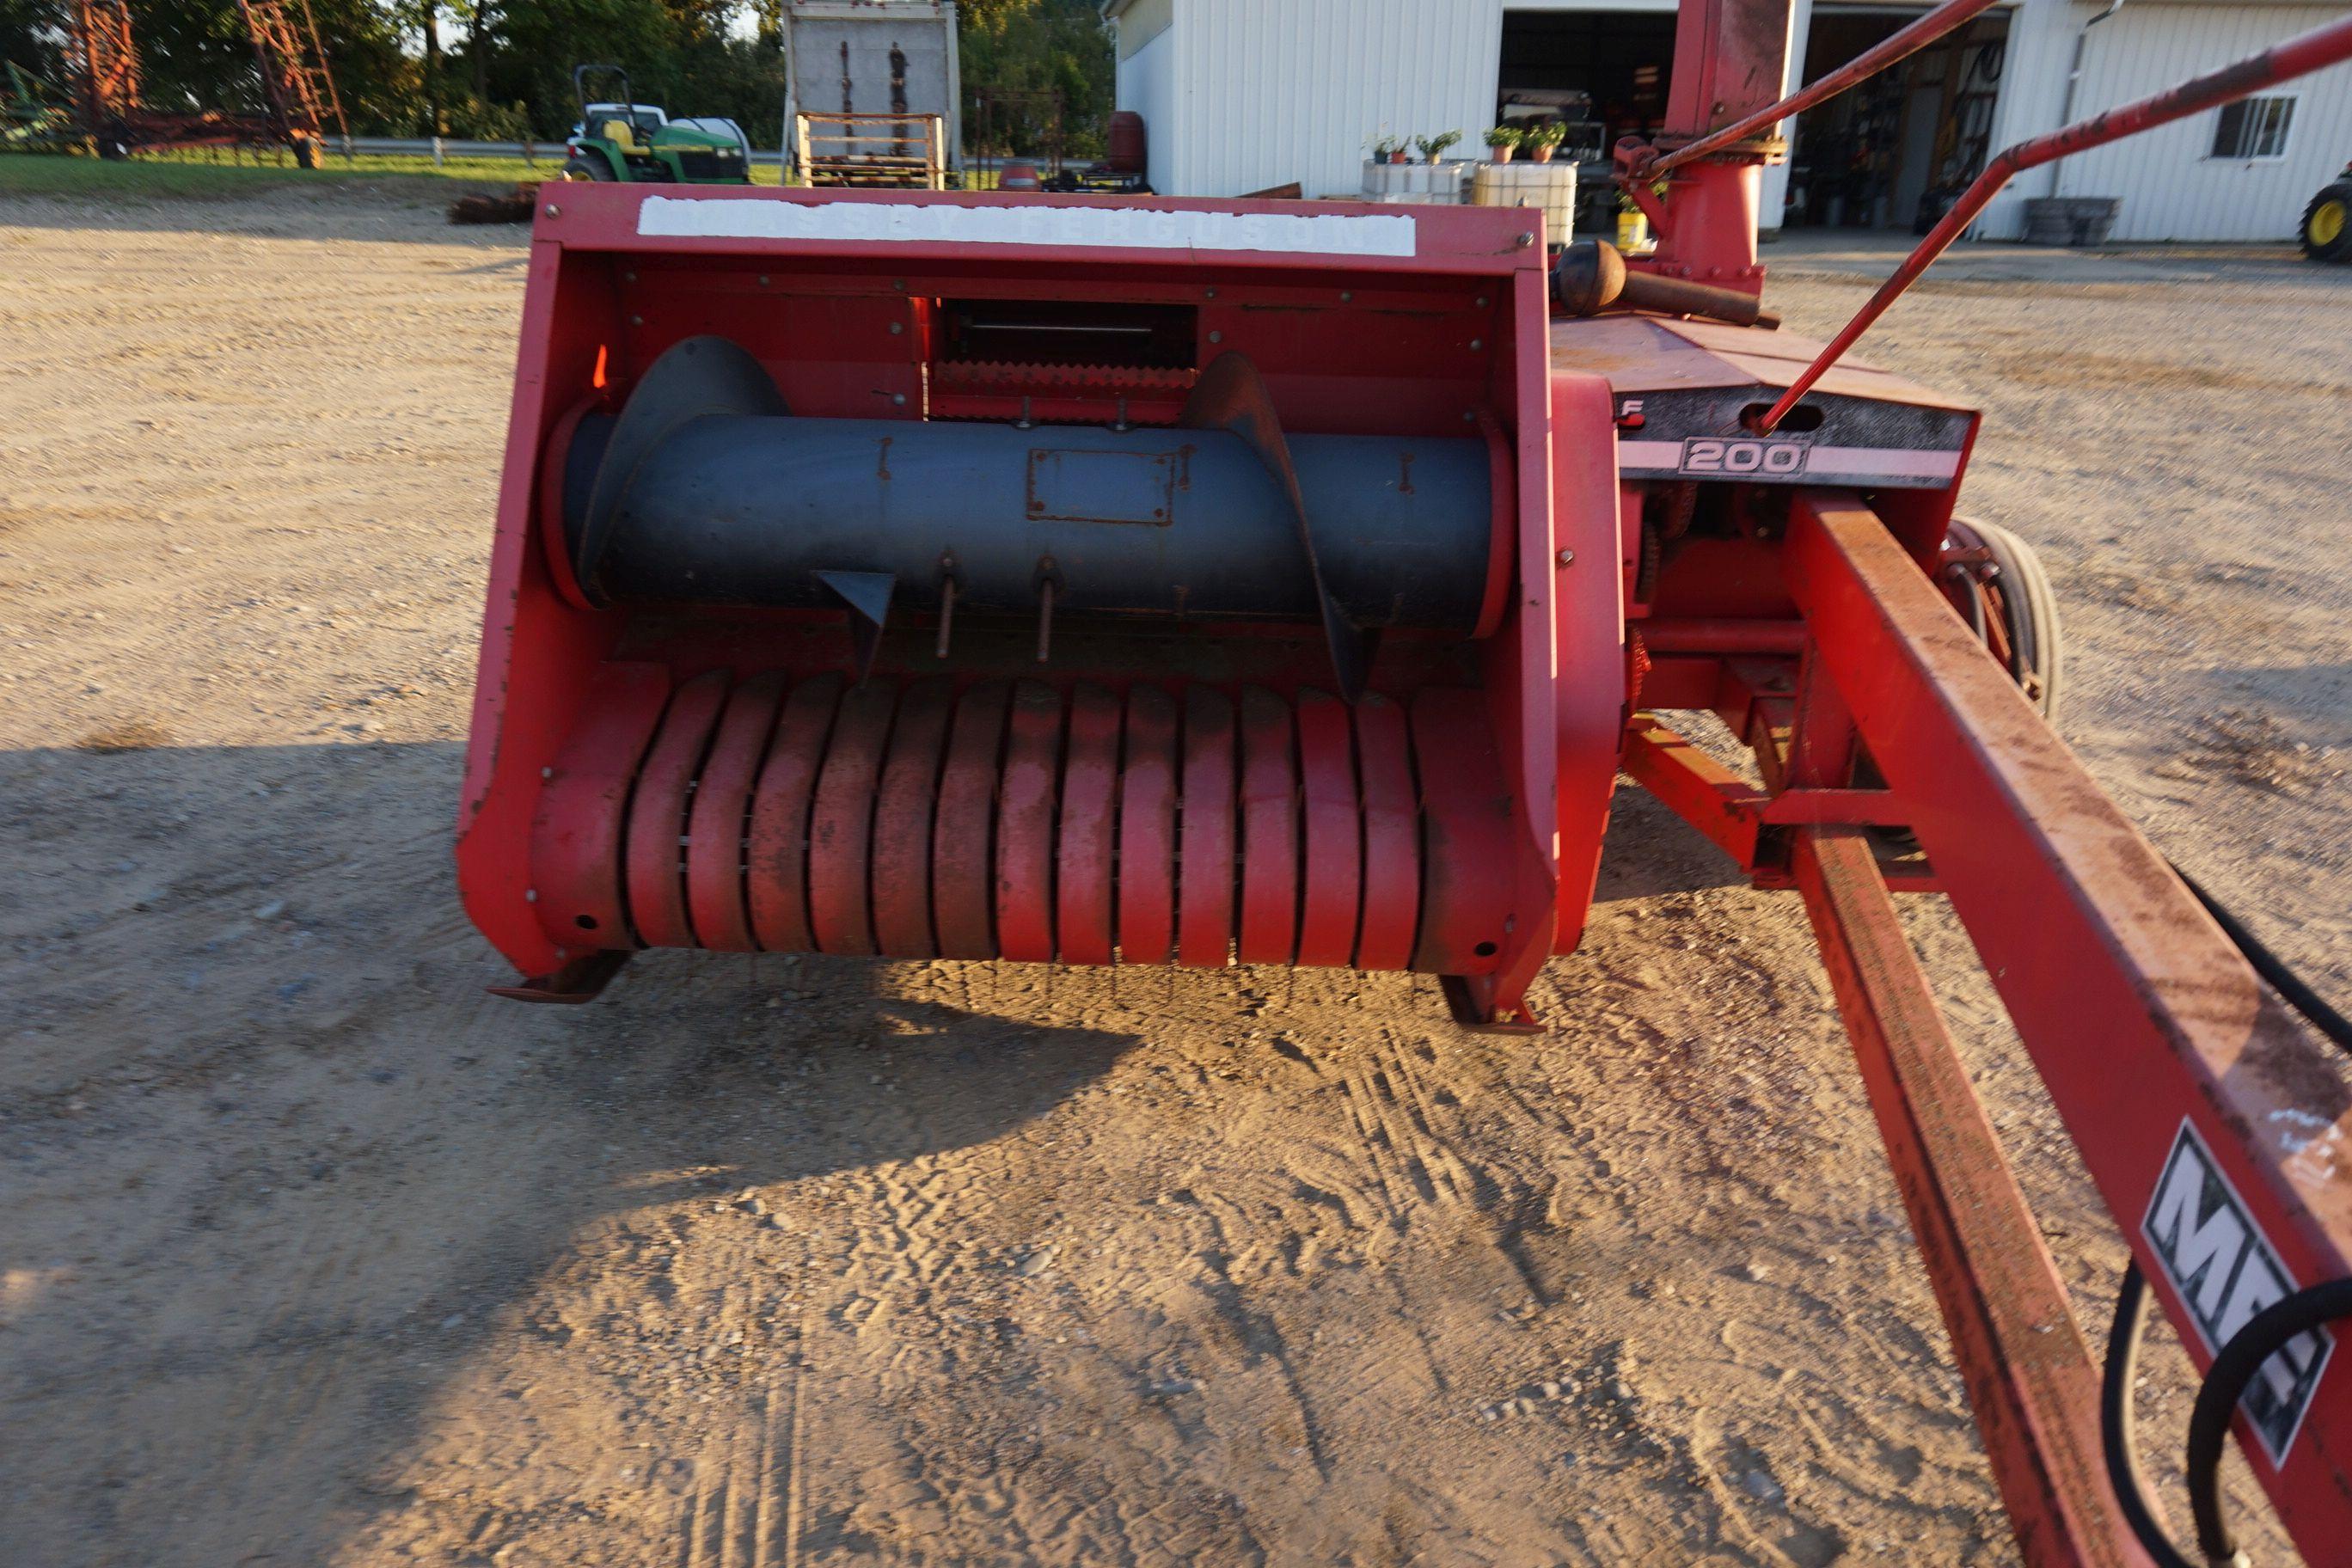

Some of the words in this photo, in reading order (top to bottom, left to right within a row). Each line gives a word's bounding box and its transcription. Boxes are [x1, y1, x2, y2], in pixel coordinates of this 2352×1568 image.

[689, 203, 961, 236] SSEY
[1687, 442, 1801, 473] 200
[2152, 1143, 2319, 1407] MF
